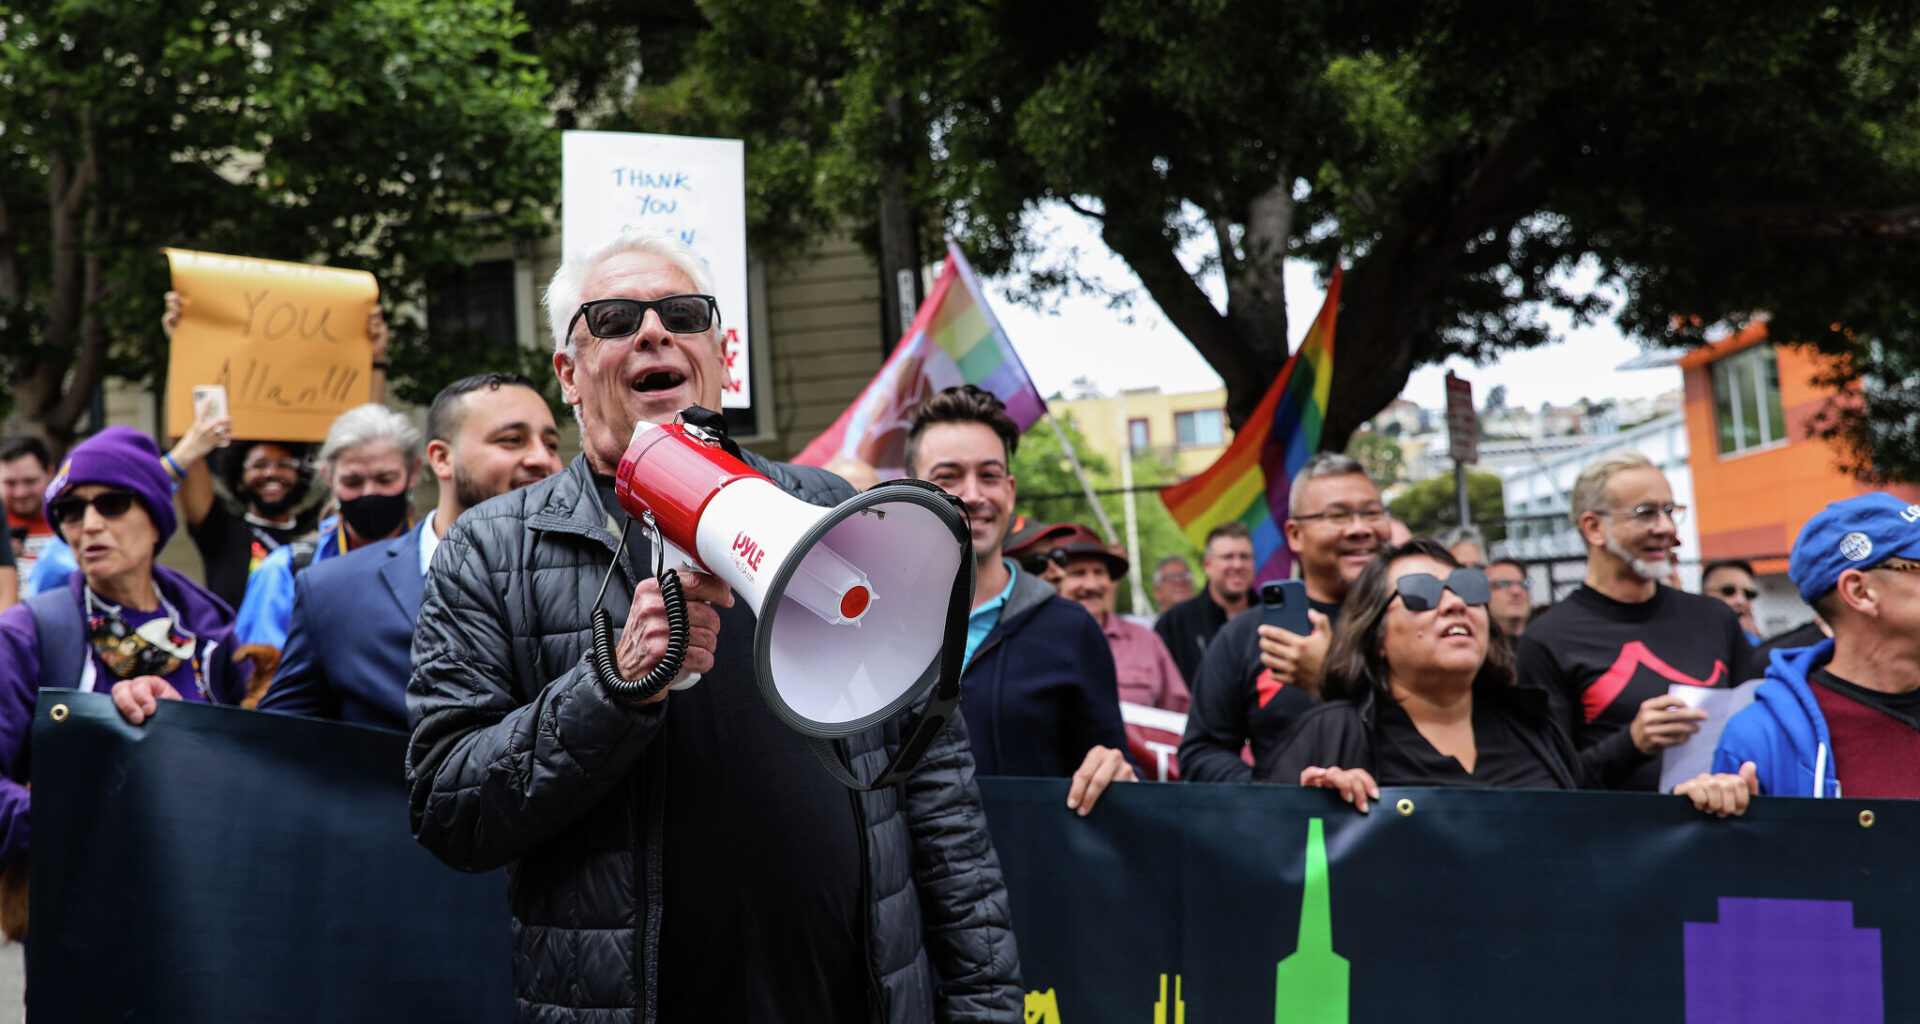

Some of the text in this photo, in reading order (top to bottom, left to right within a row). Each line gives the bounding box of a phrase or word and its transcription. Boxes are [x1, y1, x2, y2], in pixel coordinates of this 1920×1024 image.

[611, 166, 692, 191] THANK
[636, 194, 677, 216] YOU
[732, 530, 765, 572] PYLE
